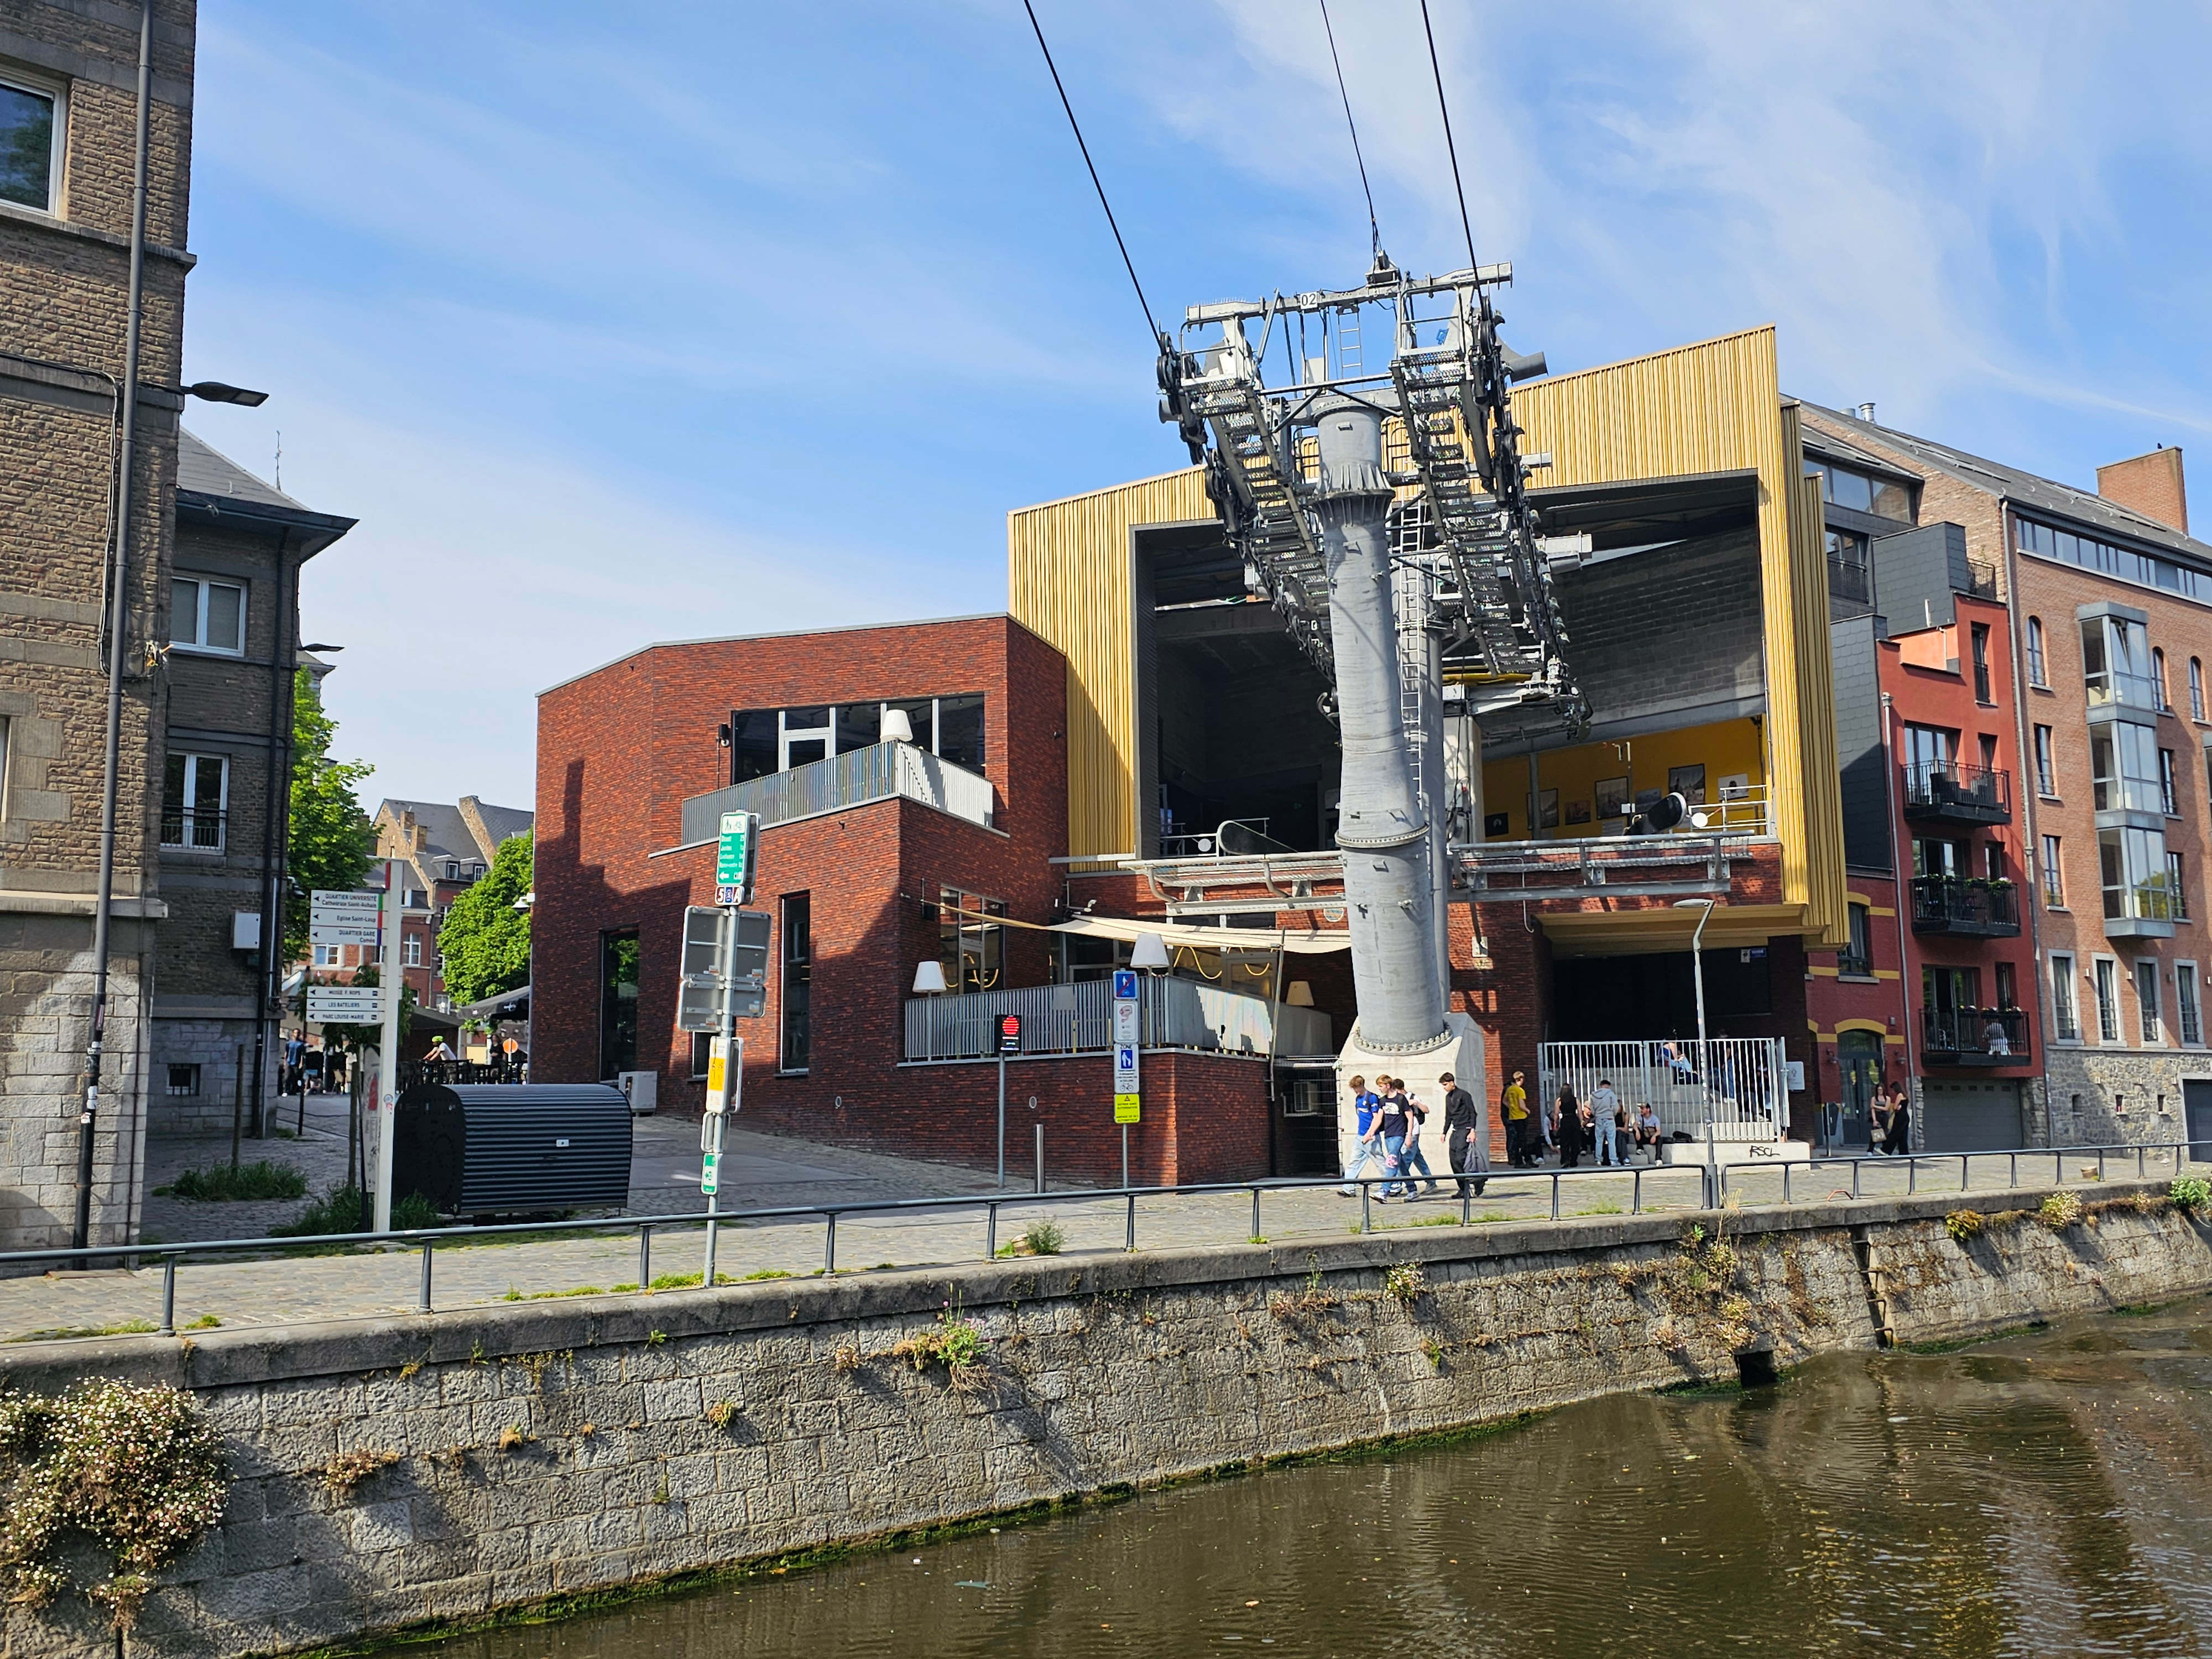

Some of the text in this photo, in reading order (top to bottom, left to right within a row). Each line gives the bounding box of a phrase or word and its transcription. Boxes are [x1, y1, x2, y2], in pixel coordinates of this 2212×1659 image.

[1302, 294, 1316, 306] 02
[717, 888, 741, 902] 5 A
